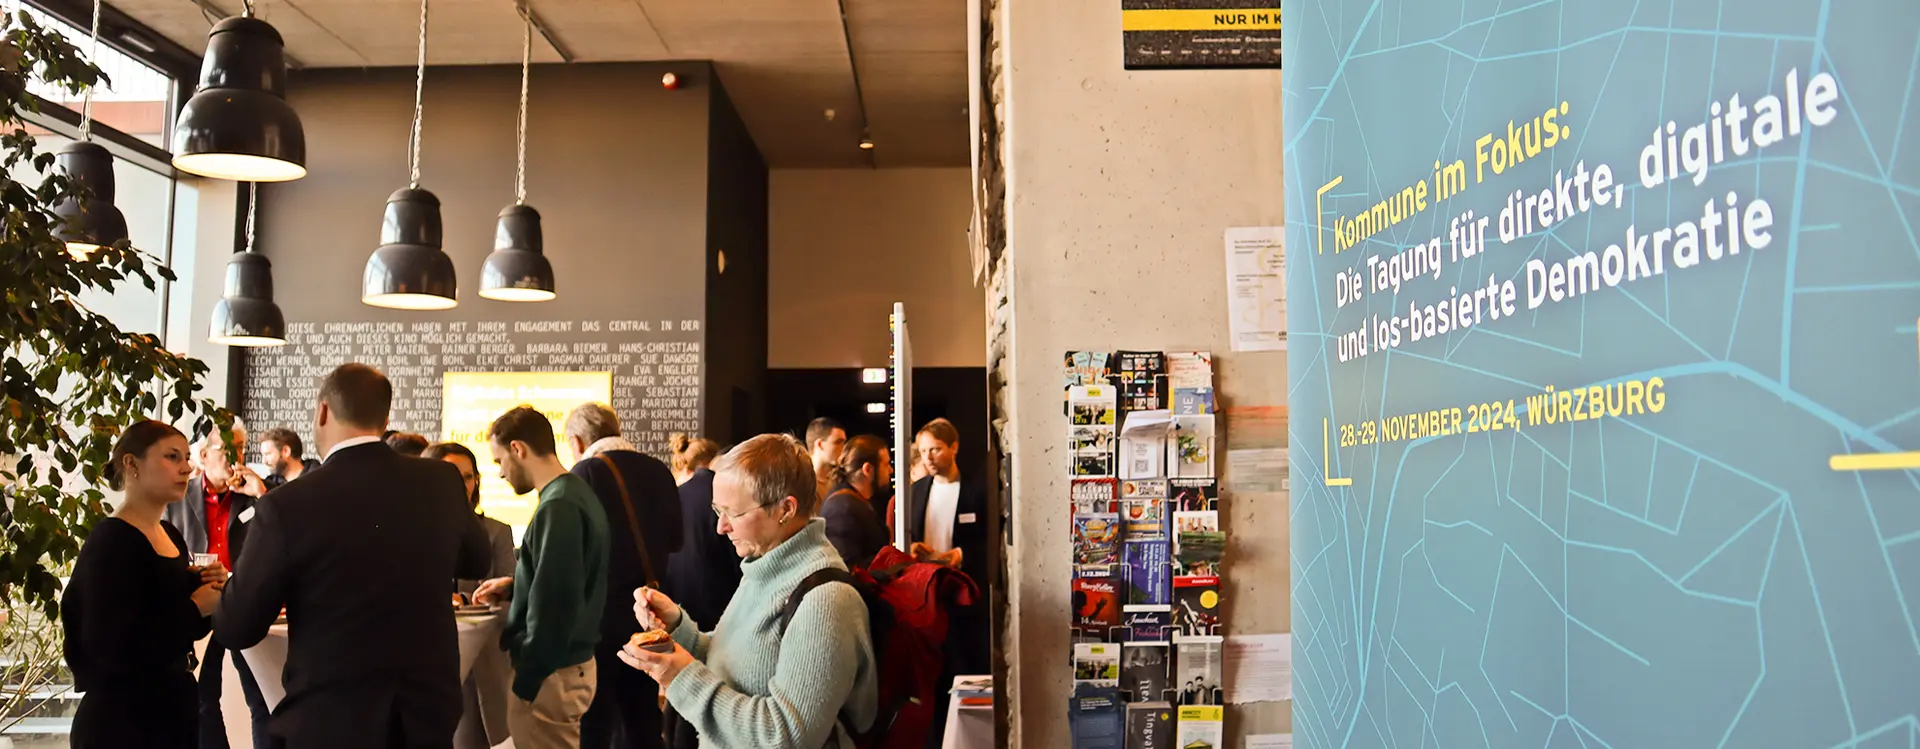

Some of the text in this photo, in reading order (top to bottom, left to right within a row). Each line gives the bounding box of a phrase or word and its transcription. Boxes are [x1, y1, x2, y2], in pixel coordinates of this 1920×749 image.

[1214, 14, 1282, 25] NUR IM K
[1334, 103, 1570, 253] Kommune im Fokus:
[1336, 69, 1839, 309] Die Tagung für direkte, digitale
[1337, 192, 1773, 363] und los-basierte Demokratie
[288, 320, 699, 333] DIESE EHRENAMTLICHEN HABEN MIT IHREM ENGAGEMENT DAS CENTRAL IN DER
[307, 334, 324, 344] UND
[328, 334, 351, 344] AUCH
[356, 334, 389, 344] DIESES
[394, 334, 416, 344] KINO
[421, 332, 461, 343] MÖGLICH
[294, 345, 306, 355] AL
[312, 345, 351, 355] GHUSAIN
[363, 345, 391, 355] PETER
[396, 345, 428, 354] BAIERL
[441, 344, 475, 354] RAINER
[481, 344, 515, 354] BERGER
[526, 343, 567, 353] BARBARA
[573, 343, 607, 353] BIEMER
[619, 342, 699, 353] HANS-CHRISTIAN
[276, 356, 310, 366] WERNER
[354, 355, 382, 365] ERIKA
[387, 355, 408, 365] BOHL
[420, 355, 437, 365] UWE
[442, 355, 464, 365] BOHL
[476, 355, 499, 365] ELKE
[504, 354, 538, 365] CHRIST
[548, 354, 584, 364] DAGMAR
[589, 354, 629, 364] DAUERER
[640, 354, 657, 364] SUE
[663, 353, 698, 364] DAWSON
[388, 366, 434, 376] DORNHEIM
[633, 365, 651, 375] EVA
[658, 365, 698, 375] ENGLERT
[286, 377, 314, 388] ESSER
[417, 377, 444, 387] ROLAN
[663, 376, 698, 386] JOCHEN
[289, 388, 320, 399] DOROT
[412, 388, 444, 399] MARKU
[646, 387, 699, 397] SEBASTIAN
[270, 400, 302, 410] BIRGIT
[415, 399, 442, 410] BIRGI
[612, 398, 636, 409] ORFF
[641, 398, 677, 409] MARION
[680, 398, 698, 409] GUT
[1183, 397, 1194, 414] NE
[242, 410, 270, 421] DAVID
[273, 410, 308, 421] HERZOG
[406, 410, 443, 421] MATTHIA
[1340, 377, 1666, 447] 28.-29. NOVEMBER 2024, WÜRZBURG
[286, 421, 315, 431] KIRCH
[414, 421, 436, 432] KIPP
[651, 420, 698, 431] BERTHOLD
[621, 431, 664, 442] RISTIAN
